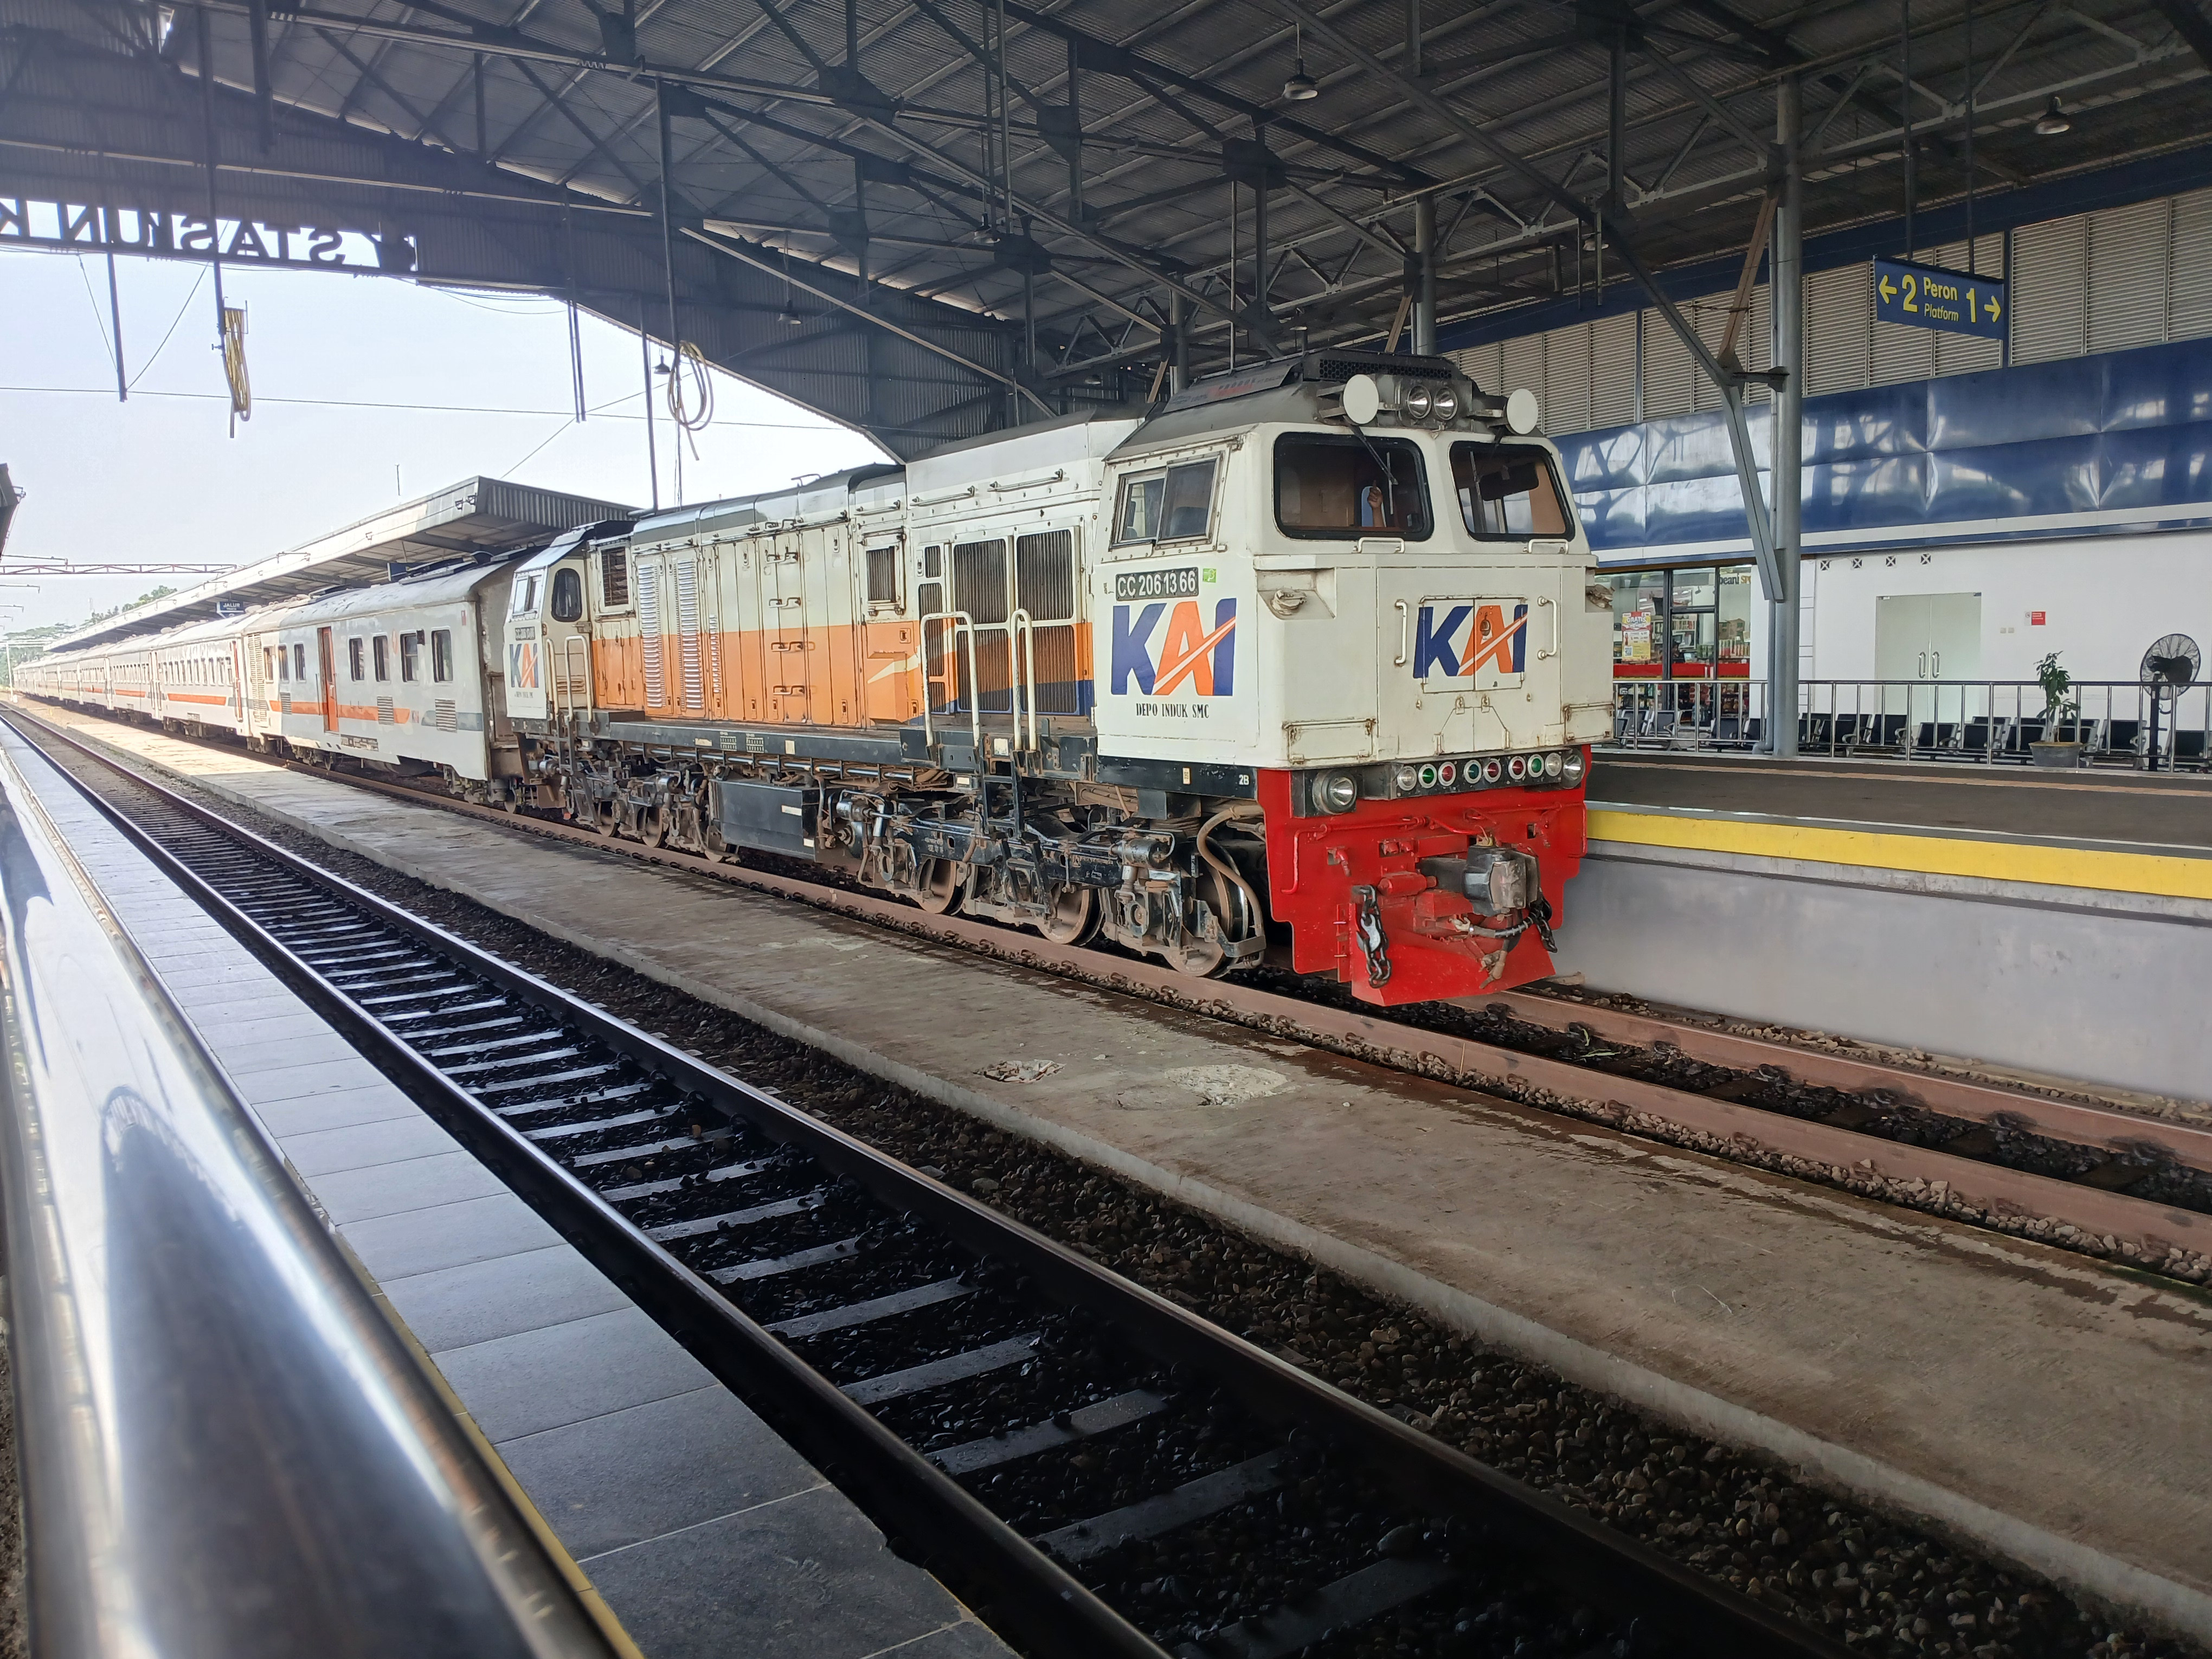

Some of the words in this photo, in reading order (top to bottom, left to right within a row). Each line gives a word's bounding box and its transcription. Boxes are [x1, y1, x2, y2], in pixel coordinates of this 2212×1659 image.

[1902, 274, 1918, 312] 2
[1924, 277, 1958, 300] Peron
[1966, 288, 1976, 323] 1
[1924, 303, 1959, 321] Platform
[1117, 576, 1136, 597] CC
[1111, 598, 1237, 696] KAI
[1413, 605, 1528, 678] KAI
[510, 643, 539, 687] KAI
[1136, 703, 1158, 716] DEPO
[1162, 704, 1188, 717] INDUK
[1192, 704, 1209, 718] SMC
[1238, 774, 1249, 785] 2B
